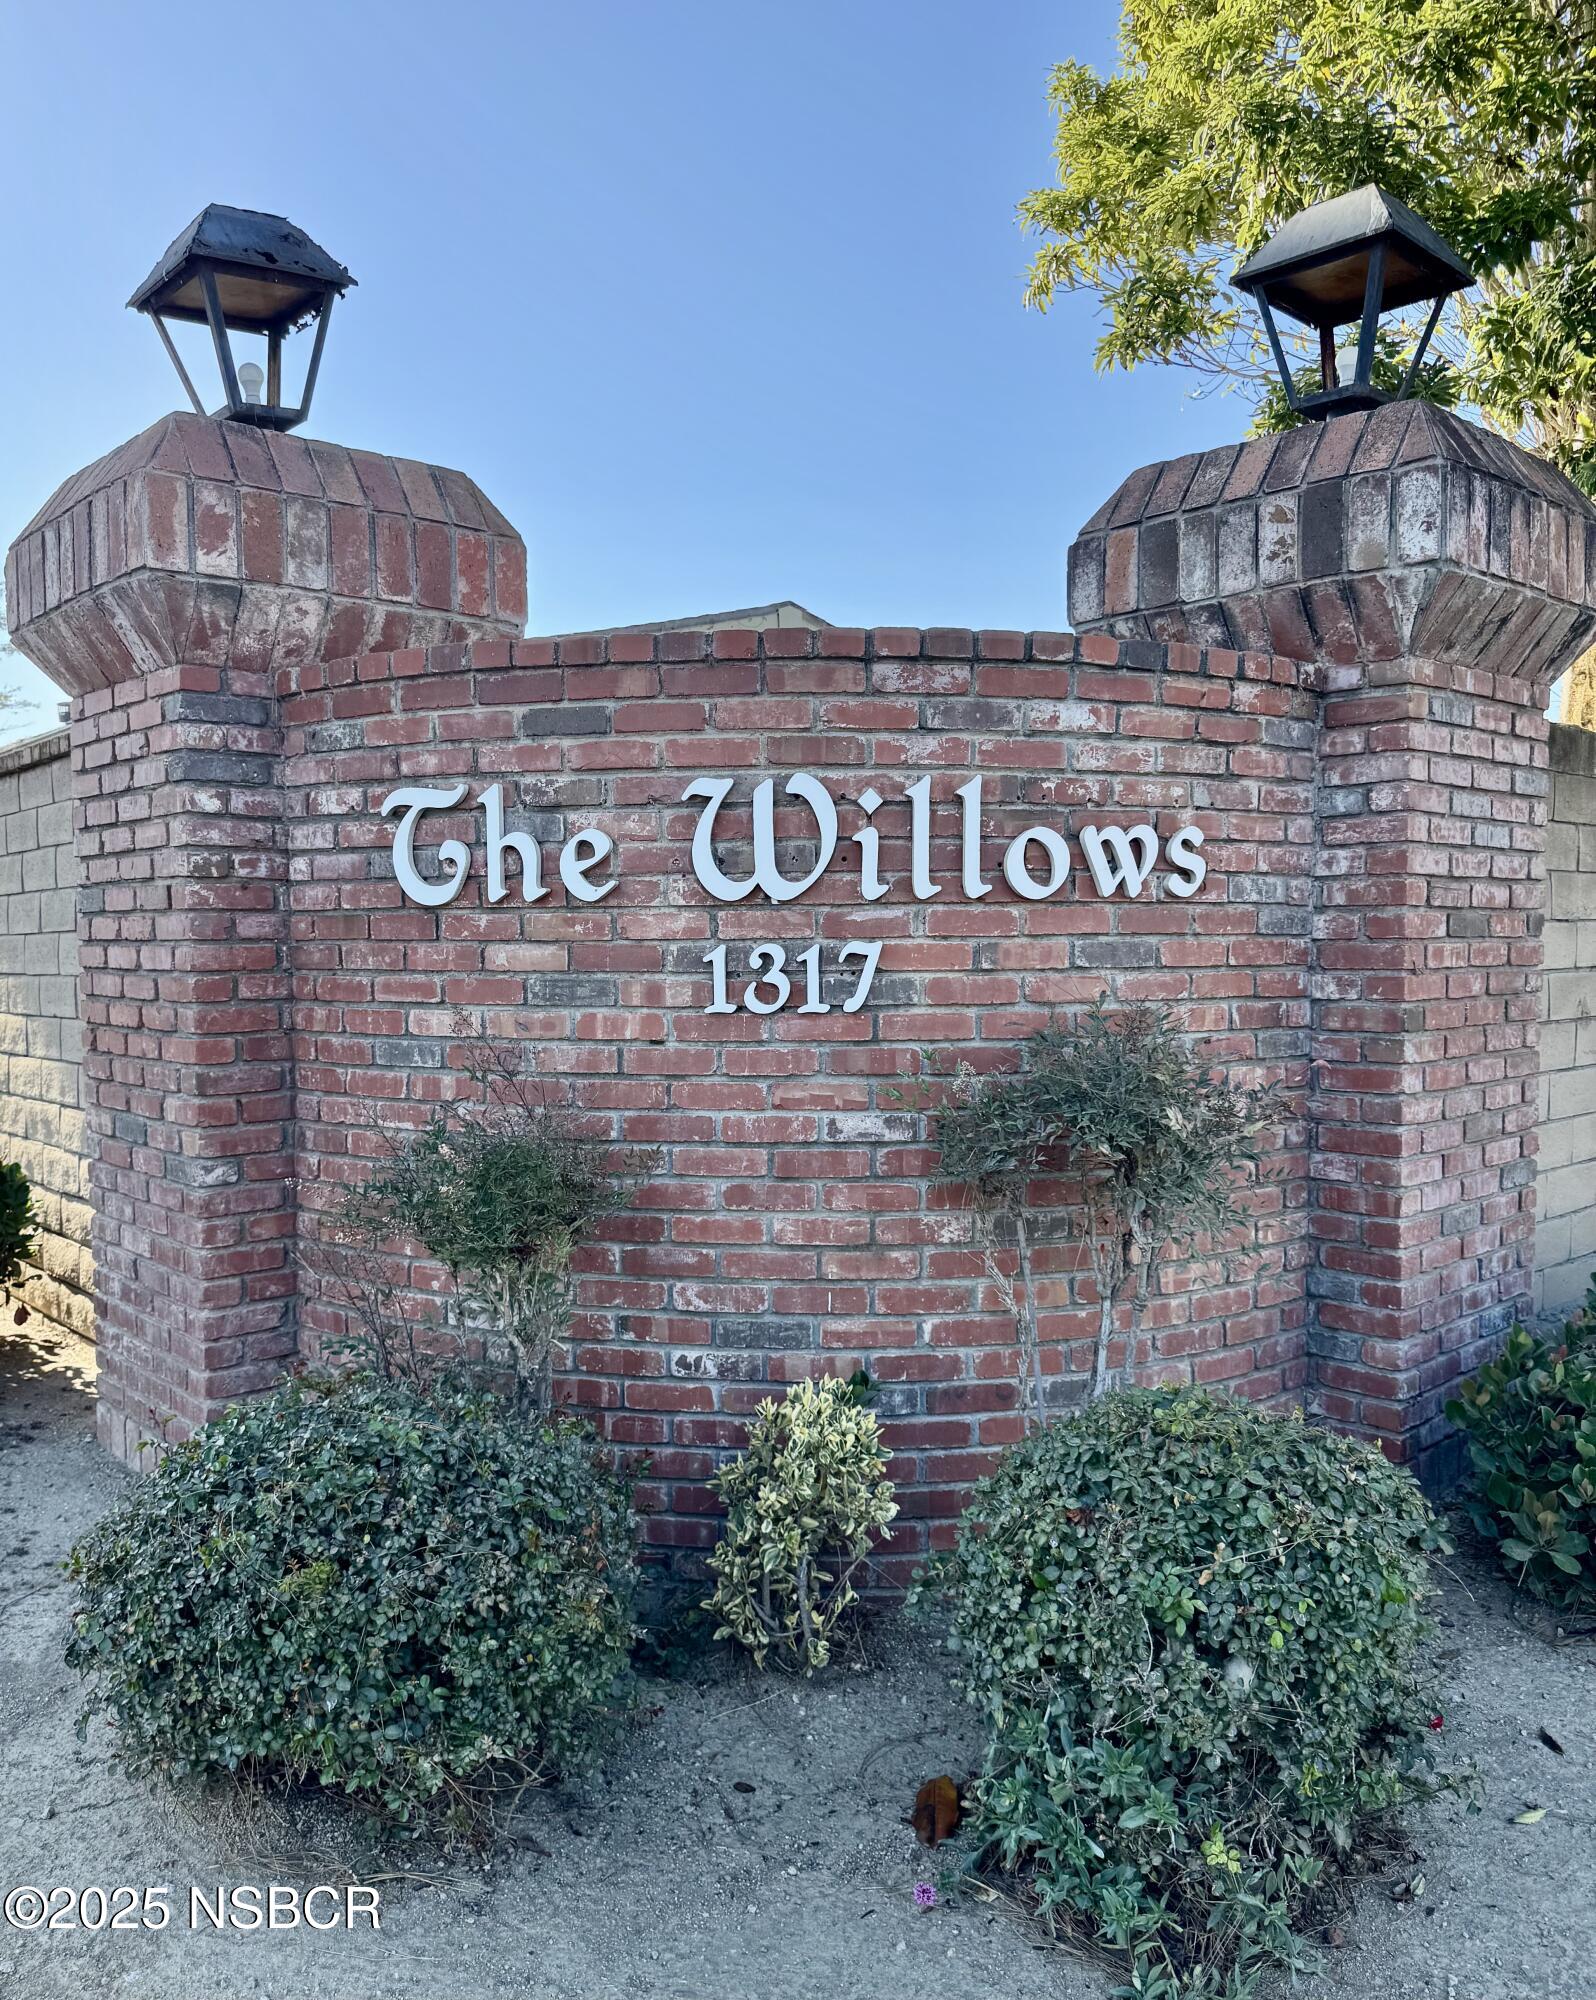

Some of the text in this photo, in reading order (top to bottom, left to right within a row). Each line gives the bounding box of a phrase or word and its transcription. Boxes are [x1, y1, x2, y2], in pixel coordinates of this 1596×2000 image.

[381, 772, 1207, 907] The Willows
[703, 940, 883, 1015] 1317
